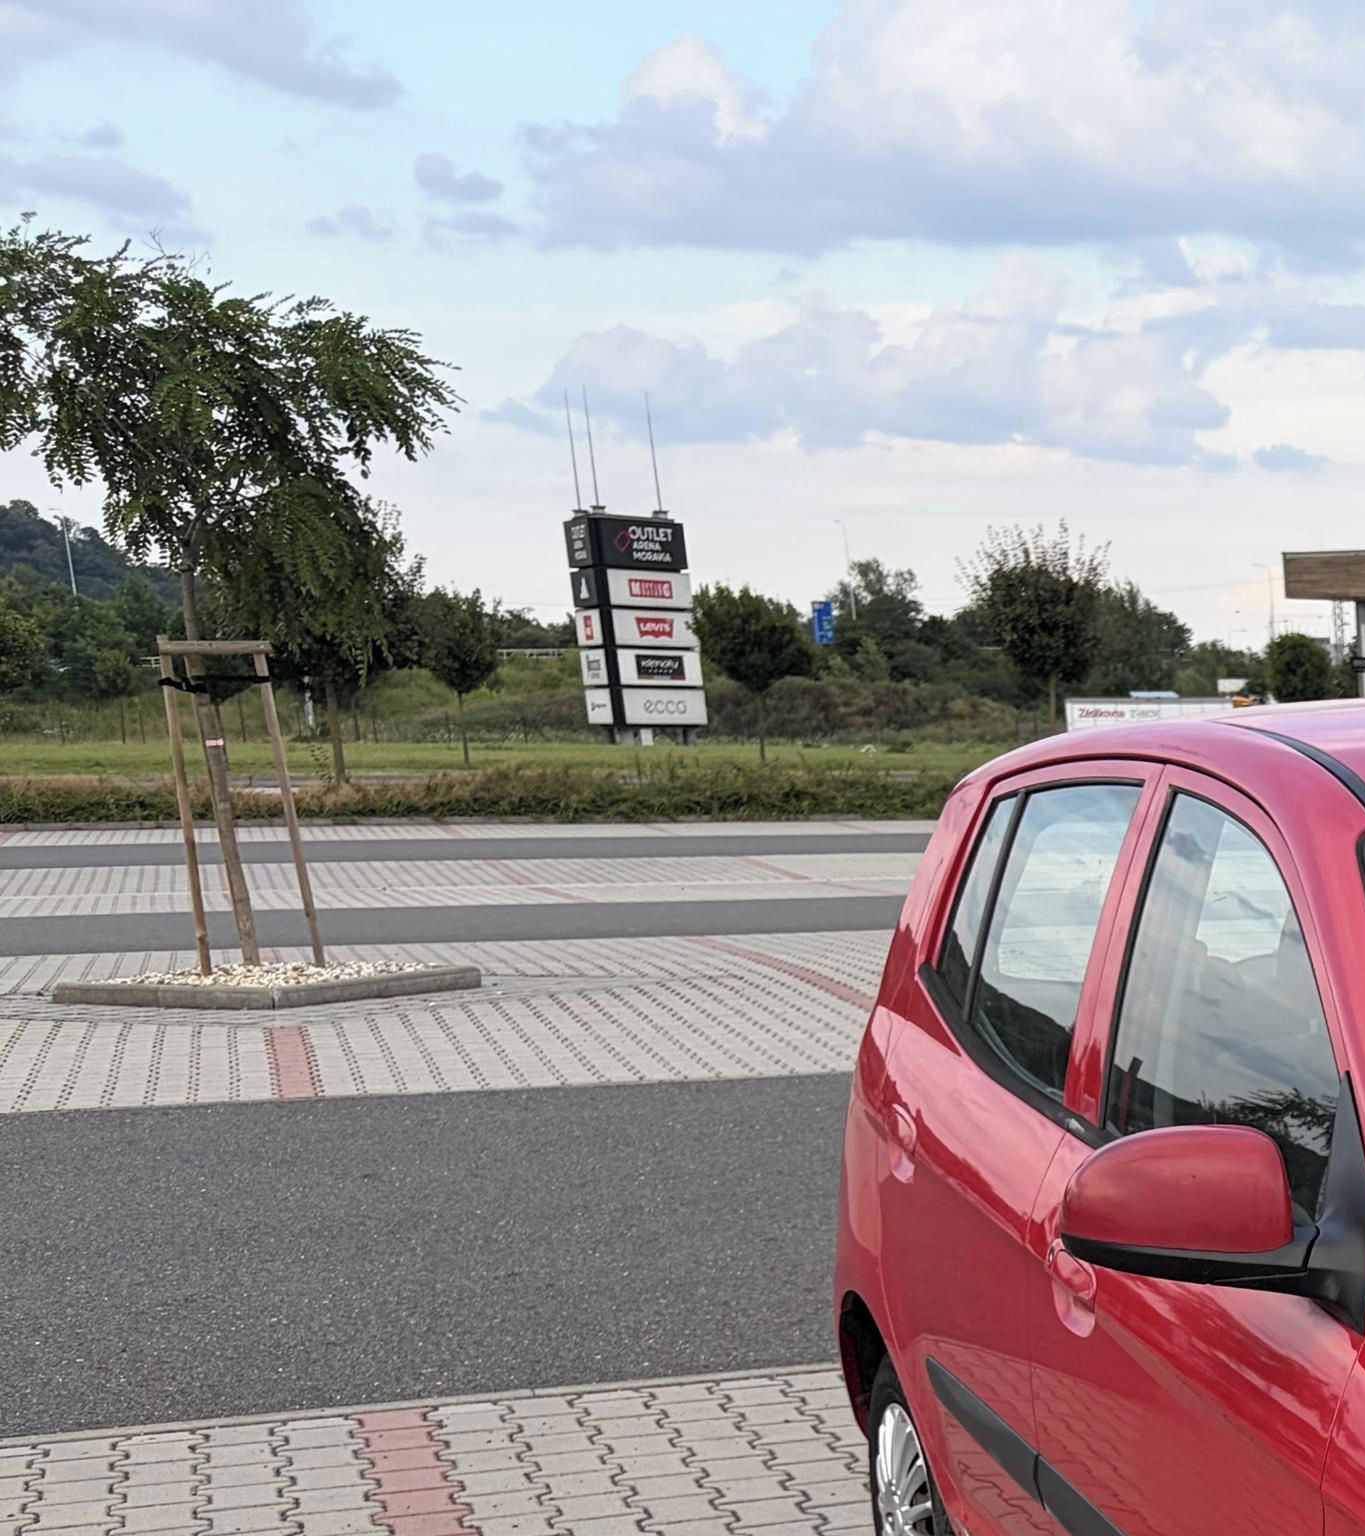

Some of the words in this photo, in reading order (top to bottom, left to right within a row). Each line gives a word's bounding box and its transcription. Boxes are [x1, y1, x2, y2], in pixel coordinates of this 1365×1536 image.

[628, 526, 672, 541] OUTLET
[633, 541, 661, 550] ARENA
[633, 551, 672, 562] MORAVIA
[643, 700, 687, 714] ecco
